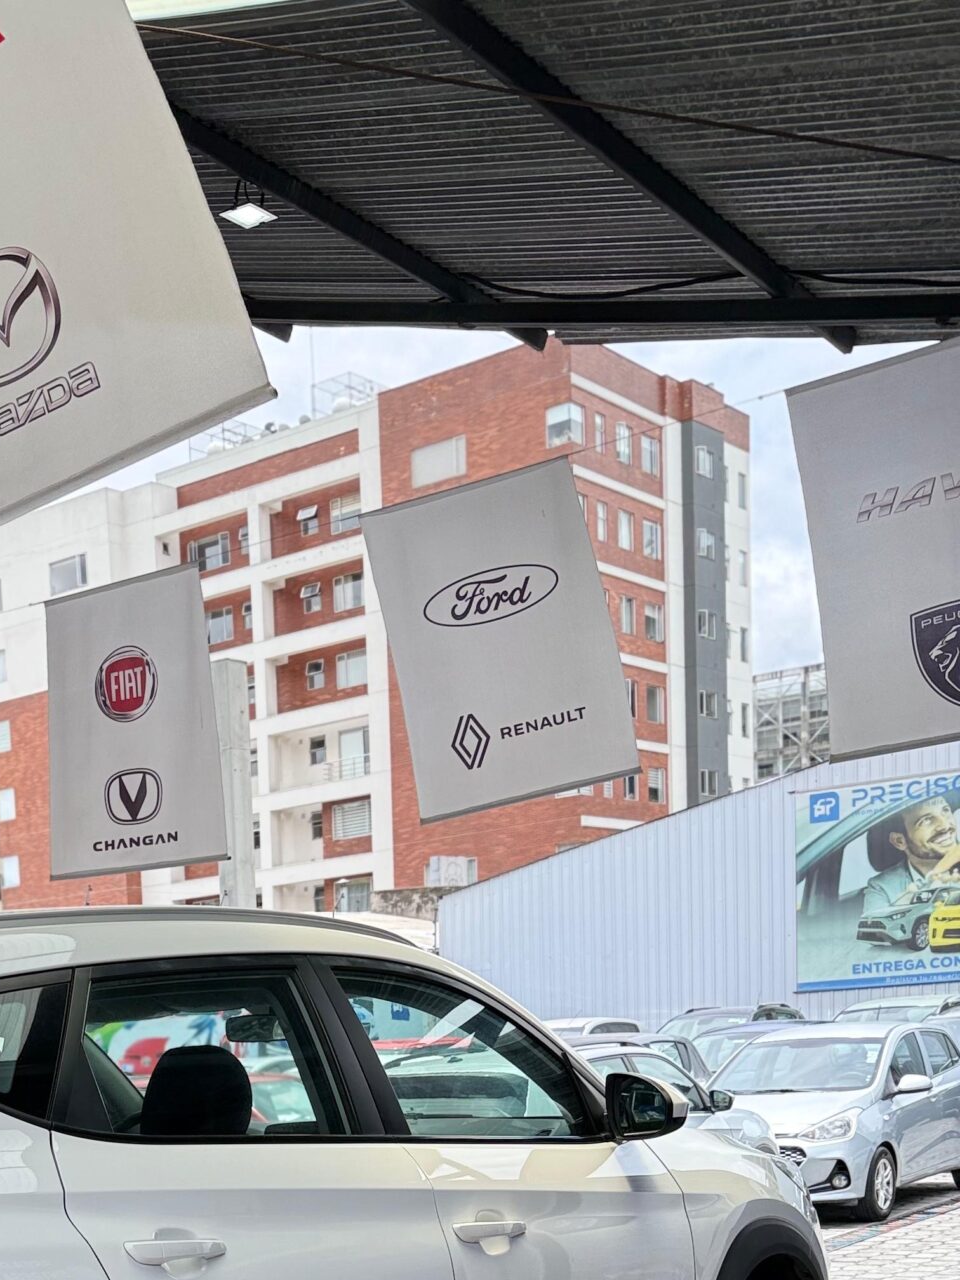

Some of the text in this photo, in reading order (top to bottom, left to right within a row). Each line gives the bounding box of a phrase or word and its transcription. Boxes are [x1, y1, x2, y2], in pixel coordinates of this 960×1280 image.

[451, 574, 532, 620] Ford
[111, 666, 143, 702] FIAT
[499, 706, 586, 739] RENAULT
[93, 831, 178, 852] CHANGAN
[852, 958, 927, 975] ENTREGA
